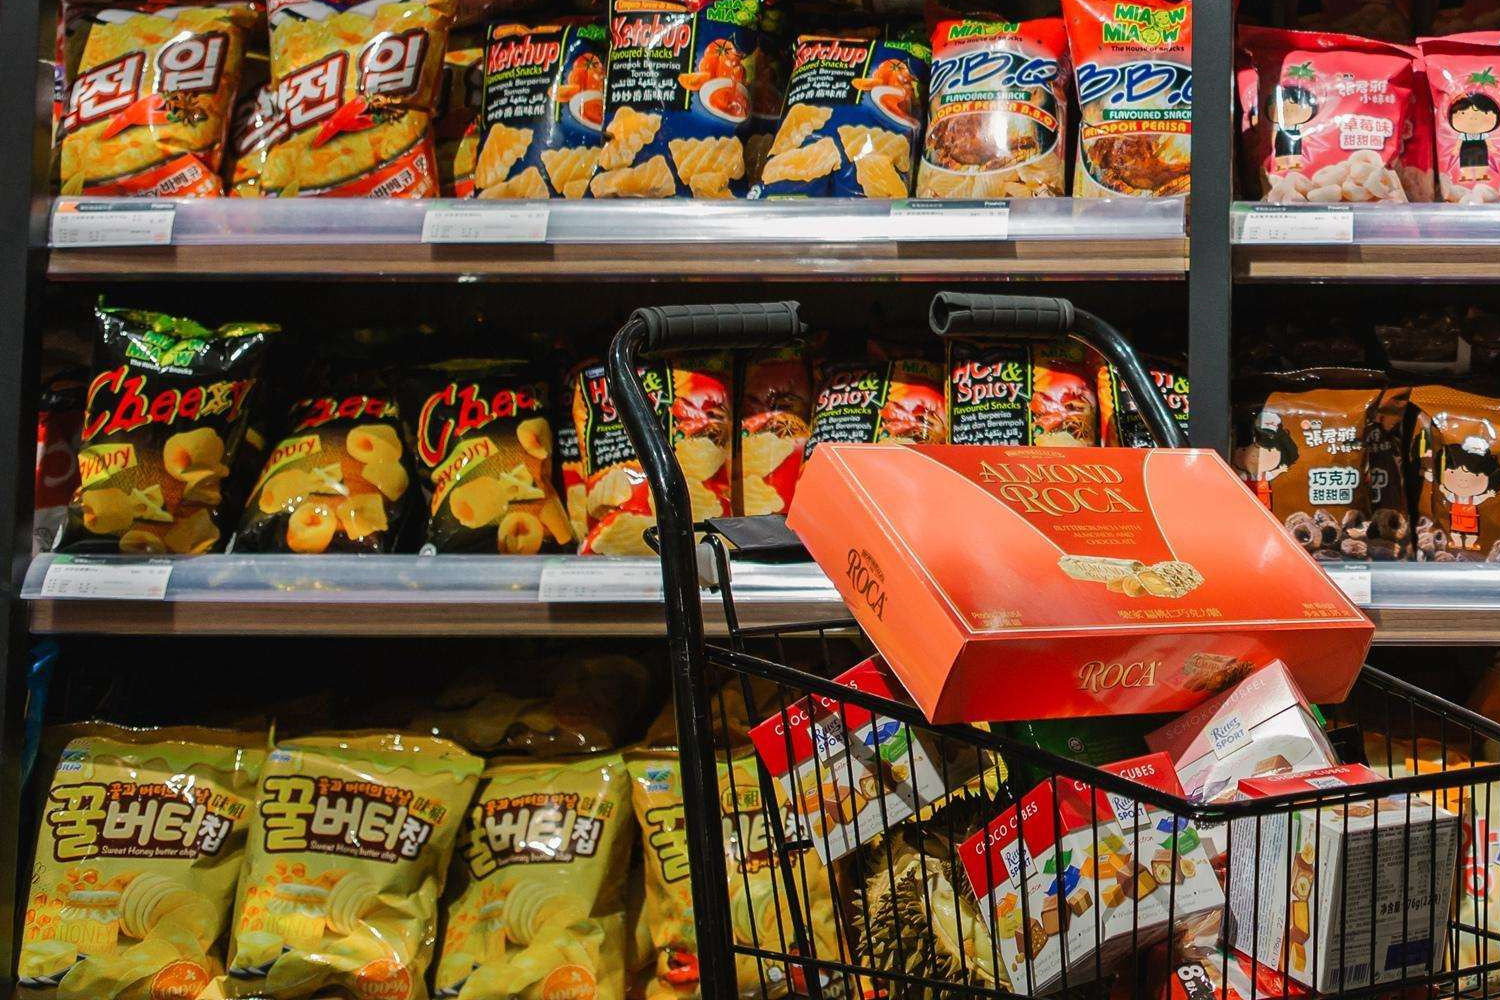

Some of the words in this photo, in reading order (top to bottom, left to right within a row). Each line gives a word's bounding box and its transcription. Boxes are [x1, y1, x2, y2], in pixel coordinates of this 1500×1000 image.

[611, 14, 692, 57] Ketchup
[487, 36, 560, 76] Ketchup
[644, 48, 673, 59] Snacks
[516, 66, 543, 77] Snacks
[825, 60, 848, 69] Snacks
[631, 70, 659, 78] Tomato
[503, 87, 530, 97] Tomato
[946, 91, 993, 102] FLAVOURED
[996, 90, 1027, 101] SNACK
[1109, 109, 1161, 120] FLAVOURED
[1164, 109, 1192, 120] SNACK
[1140, 120, 1187, 133] PERISA
[1342, 118, 1393, 134] 草莓味
[1342, 134, 1384, 148] 甜甜圈
[816, 388, 877, 412] Spicy
[957, 381, 1024, 404] Spicy
[991, 400, 1022, 411] Snacks
[987, 420, 1025, 429] Berempah
[1303, 426, 1357, 447] 張君雅
[978, 460, 1124, 484] ALMOND
[1312, 470, 1358, 488] 巧克力
[999, 484, 1144, 517] ROCA
[1312, 487, 1352, 503] 甜甜圈
[847, 548, 888, 622] ROCA
[1078, 660, 1163, 693] ROCA
[1210, 716, 1241, 741] Ritter
[1216, 728, 1246, 751] SPORT
[1120, 763, 1155, 780] CUBES
[50, 782, 231, 860] 꿀버터칩
[262, 775, 431, 860] 꿀버터칩
[1010, 800, 1039, 830] CBES
[101, 845, 127, 855] Sweet
[129, 846, 153, 858] Honey
[154, 846, 178, 856] butter
[179, 848, 198, 859] chip
